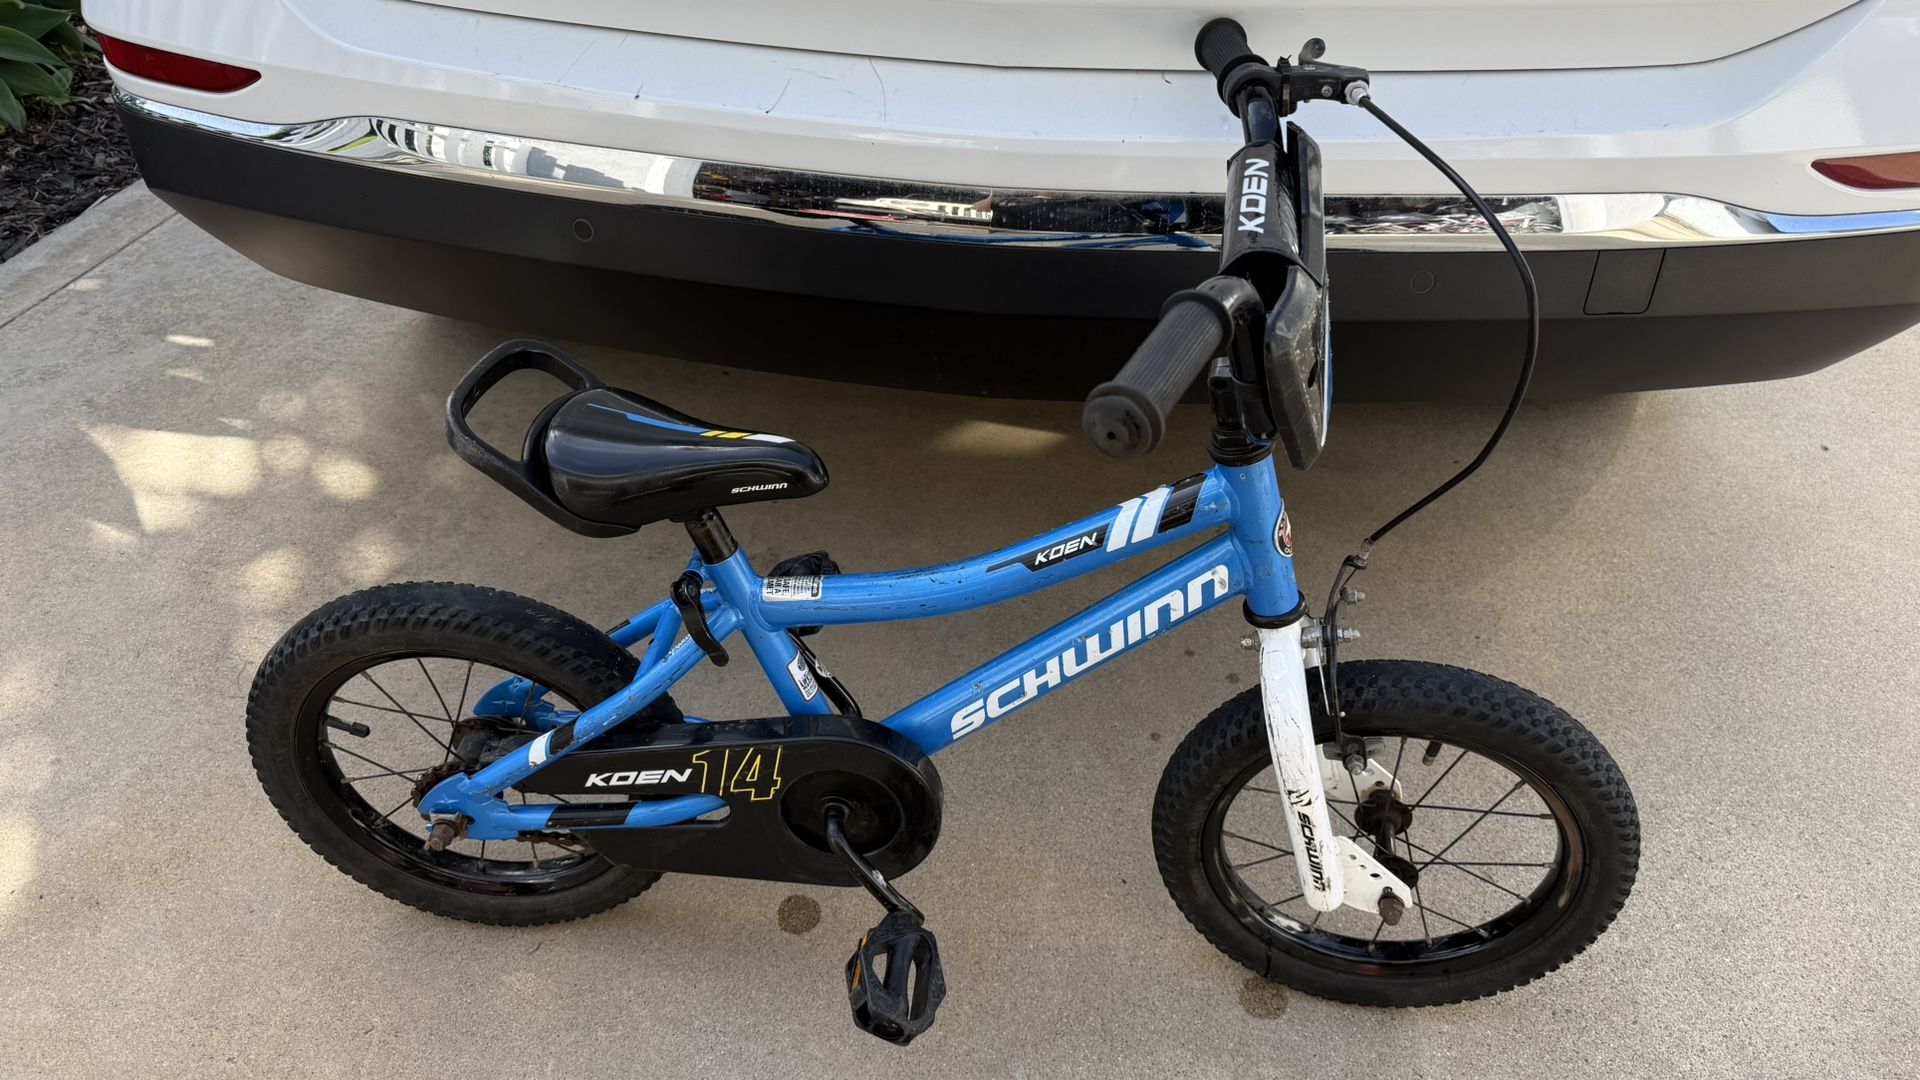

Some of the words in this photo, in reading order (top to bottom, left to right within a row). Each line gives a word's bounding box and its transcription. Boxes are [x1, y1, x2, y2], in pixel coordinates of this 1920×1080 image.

[1237, 158, 1270, 234] KOEN
[731, 482, 788, 494] SCHWINN
[1034, 532, 1099, 566] KOEN
[951, 564, 1229, 740] SCHWINN
[584, 768, 693, 788] KOEN
[692, 745, 783, 801] 14
